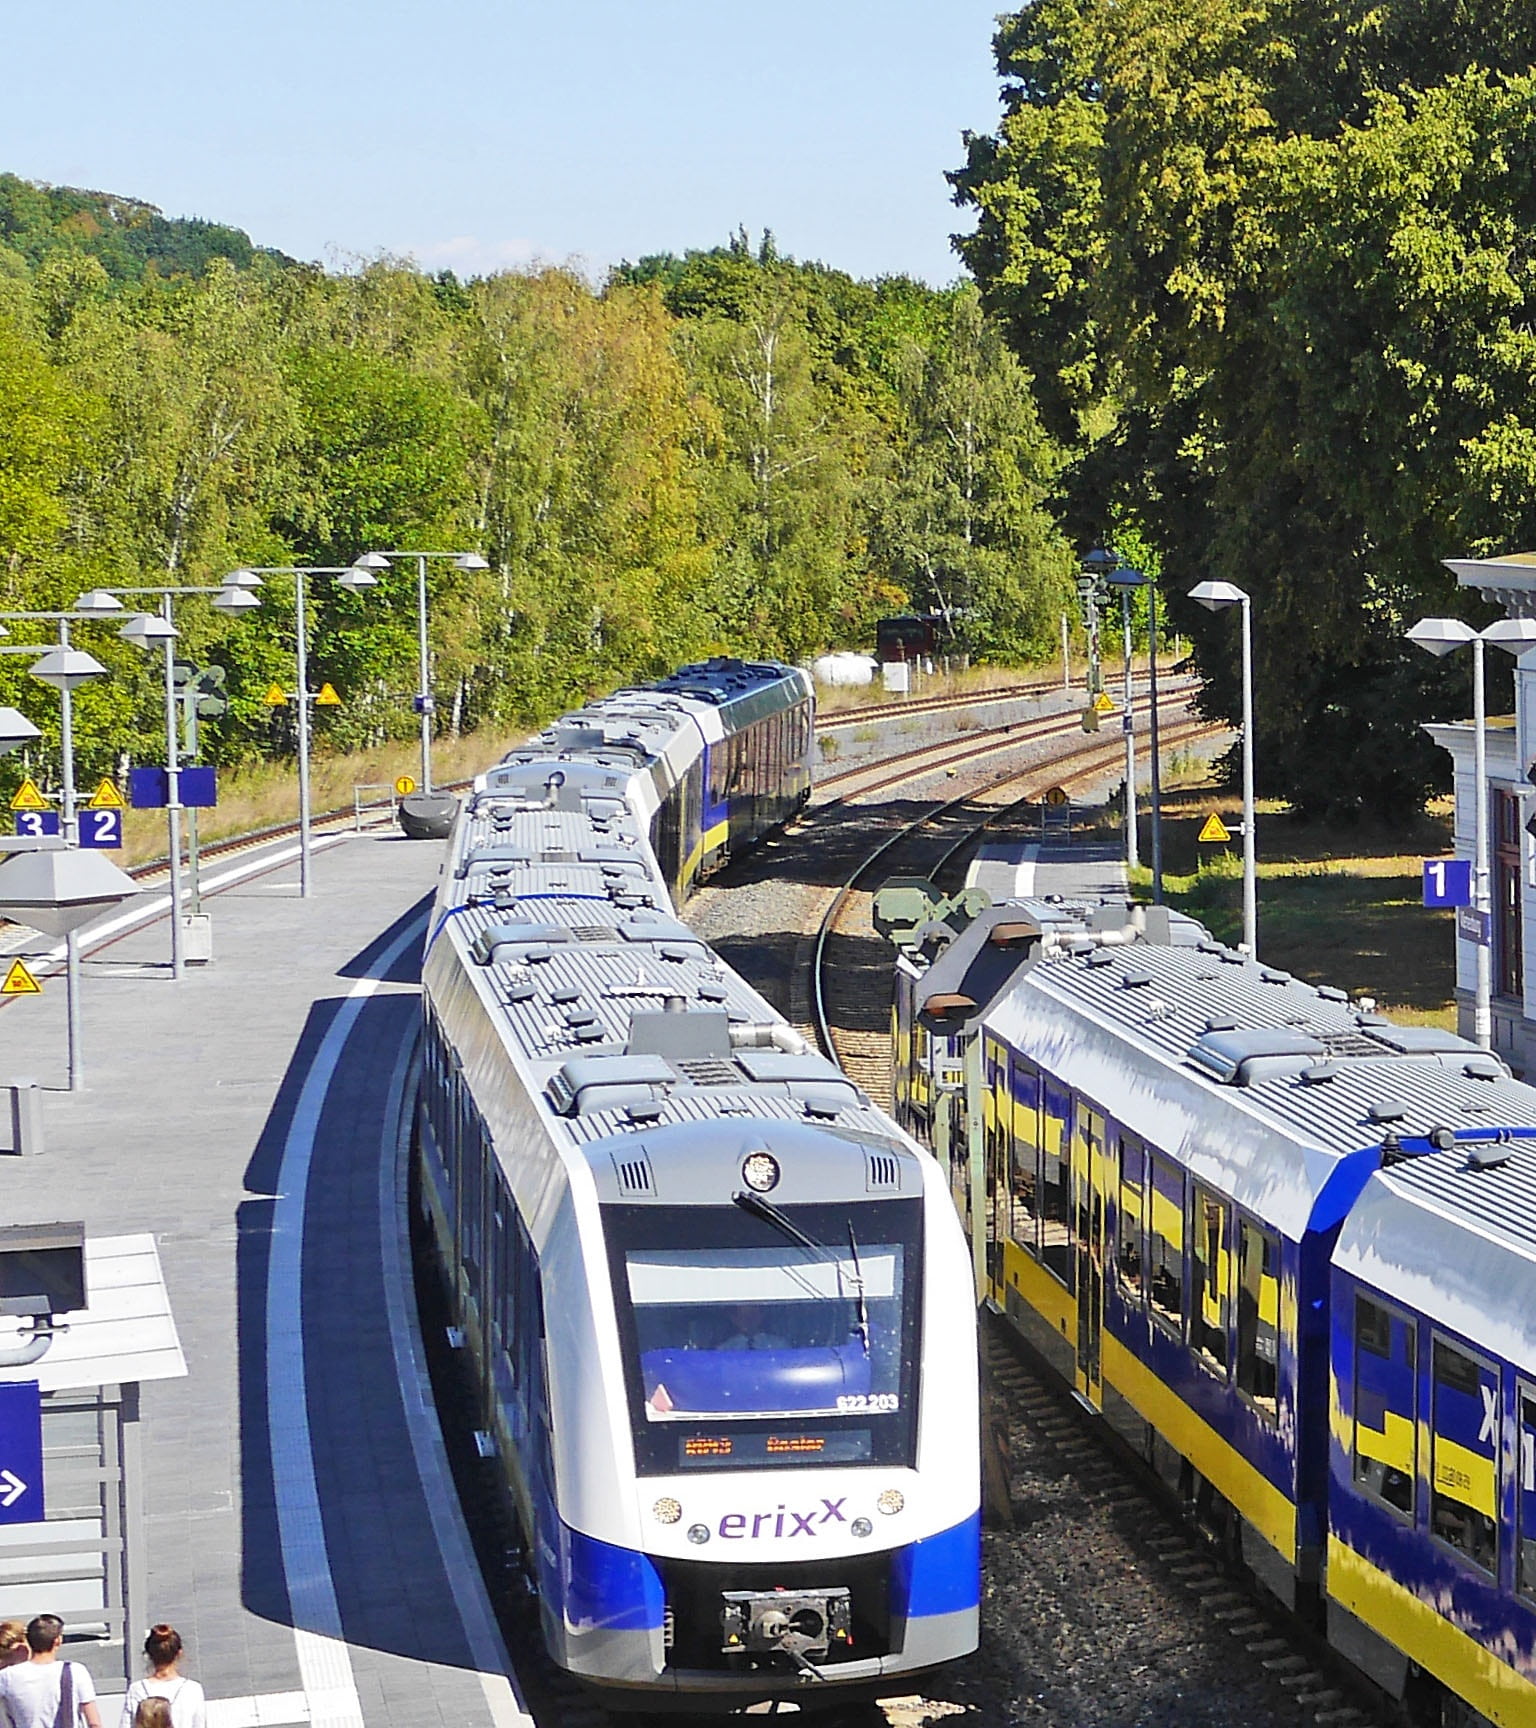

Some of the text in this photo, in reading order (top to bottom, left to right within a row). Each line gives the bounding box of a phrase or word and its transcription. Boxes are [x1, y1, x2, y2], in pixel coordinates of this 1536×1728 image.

[21, 812, 44, 837] 3
[93, 810, 117, 842] 2
[1428, 861, 1446, 897] 1
[718, 1497, 848, 1539] erixx
